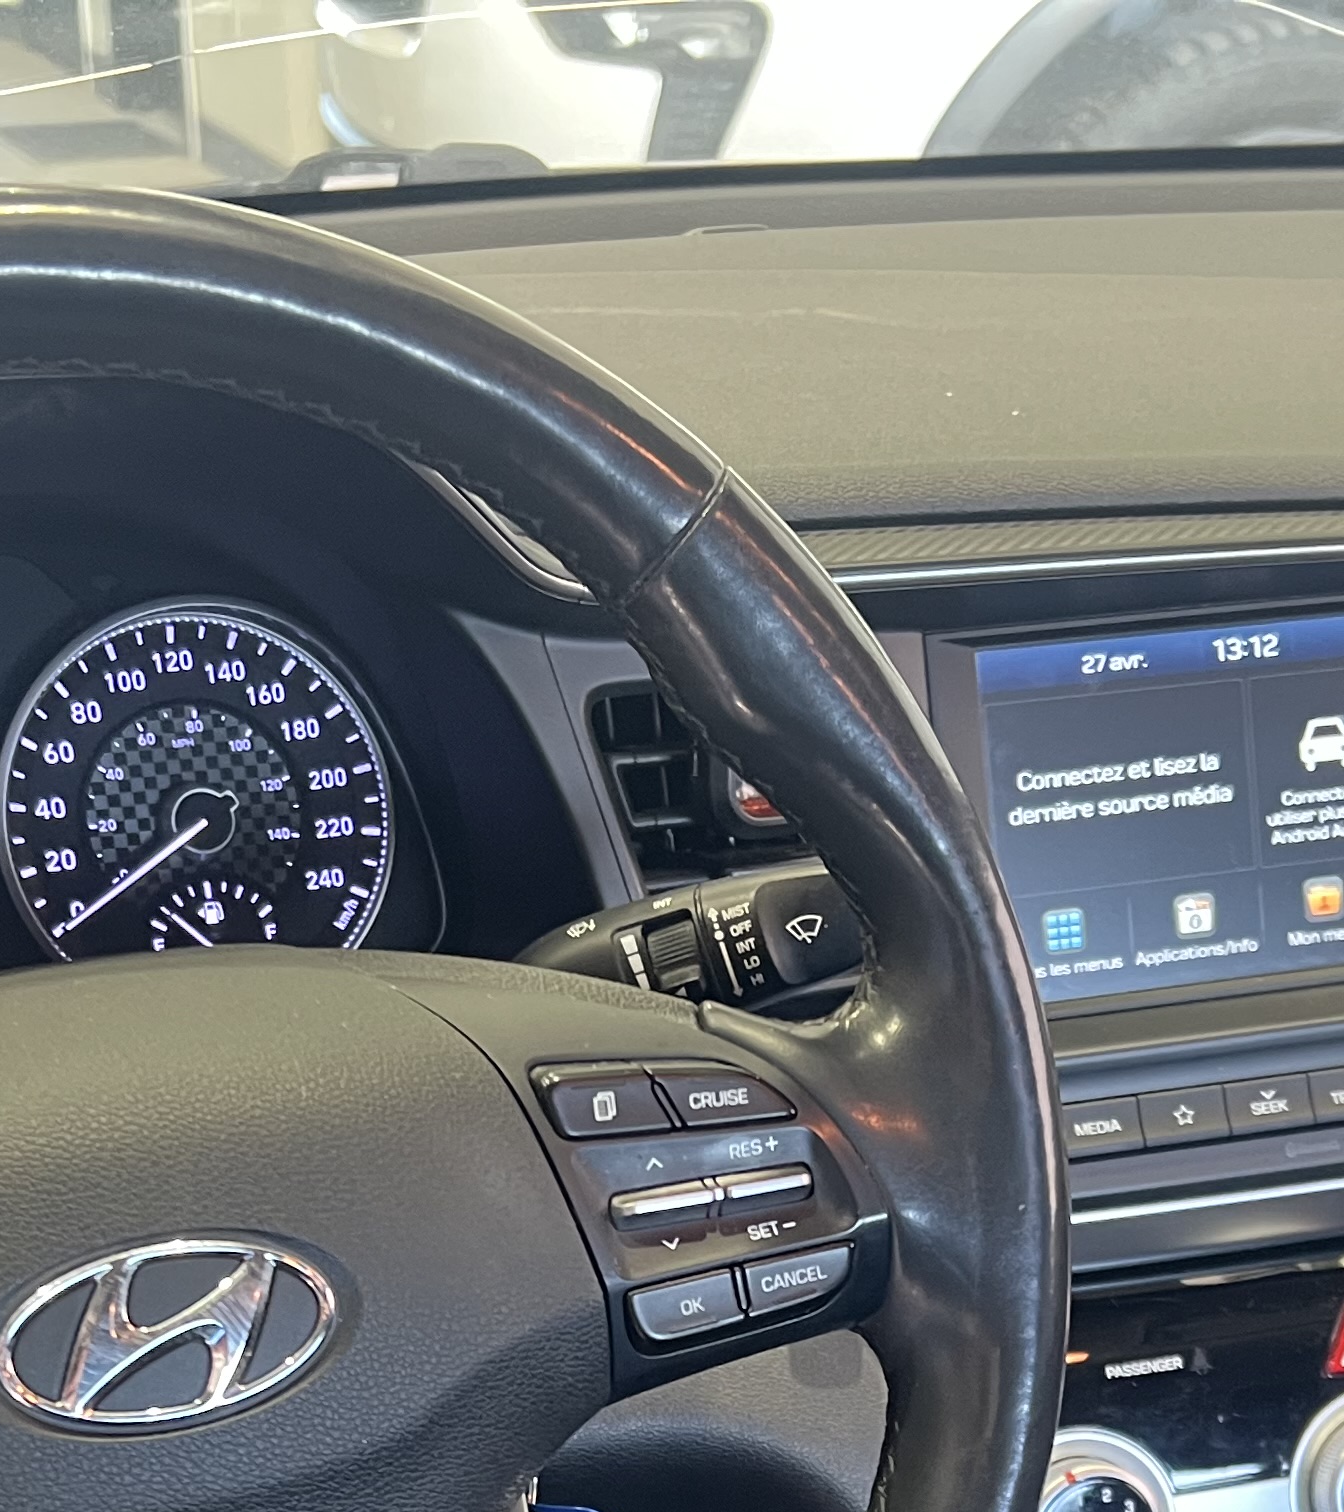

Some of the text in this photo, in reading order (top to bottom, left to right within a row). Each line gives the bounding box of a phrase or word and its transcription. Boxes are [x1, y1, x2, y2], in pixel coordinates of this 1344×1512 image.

[1212, 633, 1280, 663] 13:12
[152, 649, 194, 674] 120
[1081, 653, 1149, 675] 27 avr.
[104, 668, 146, 694] 100
[205, 660, 246, 685] 140
[245, 682, 285, 706] 160
[70, 701, 102, 725] 80
[185, 720, 204, 733] 80
[281, 717, 320, 742] 180
[137, 732, 156, 747] 60
[228, 738, 252, 752] 100
[44, 740, 75, 765] 60
[106, 767, 124, 780] 40
[309, 766, 347, 790] 200
[1016, 752, 1221, 792] Connectez et lisez la
[260, 778, 283, 793] 120
[34, 797, 67, 819] 40
[1008, 784, 1234, 826] dernière source média
[99, 819, 117, 832] 20
[314, 816, 354, 839] 220
[1265, 809, 1317, 827] utiliser
[267, 827, 290, 841] 140
[1271, 825, 1330, 845] Android
[44, 848, 77, 872] 20
[305, 868, 345, 892] 240
[653, 897, 672, 910] INT
[722, 902, 750, 921] MIST
[332, 899, 359, 931] km/h
[264, 923, 277, 940] F
[730, 919, 752, 937] OFF
[1287, 930, 1320, 946] Mon
[736, 937, 756, 954] INT
[1135, 938, 1259, 967] Applications/Info
[743, 955, 761, 970] LO
[1074, 956, 1123, 973] menus
[688, 1087, 749, 1111] CRUISE
[1249, 1099, 1290, 1116] SEEK
[1073, 1118, 1123, 1137] MEDIA
[760, 1265, 828, 1293] CANCEL
[680, 1298, 706, 1317] OK
[1104, 1353, 1185, 1380] PASSENGER
[1101, 1487, 1112, 1503] 2
